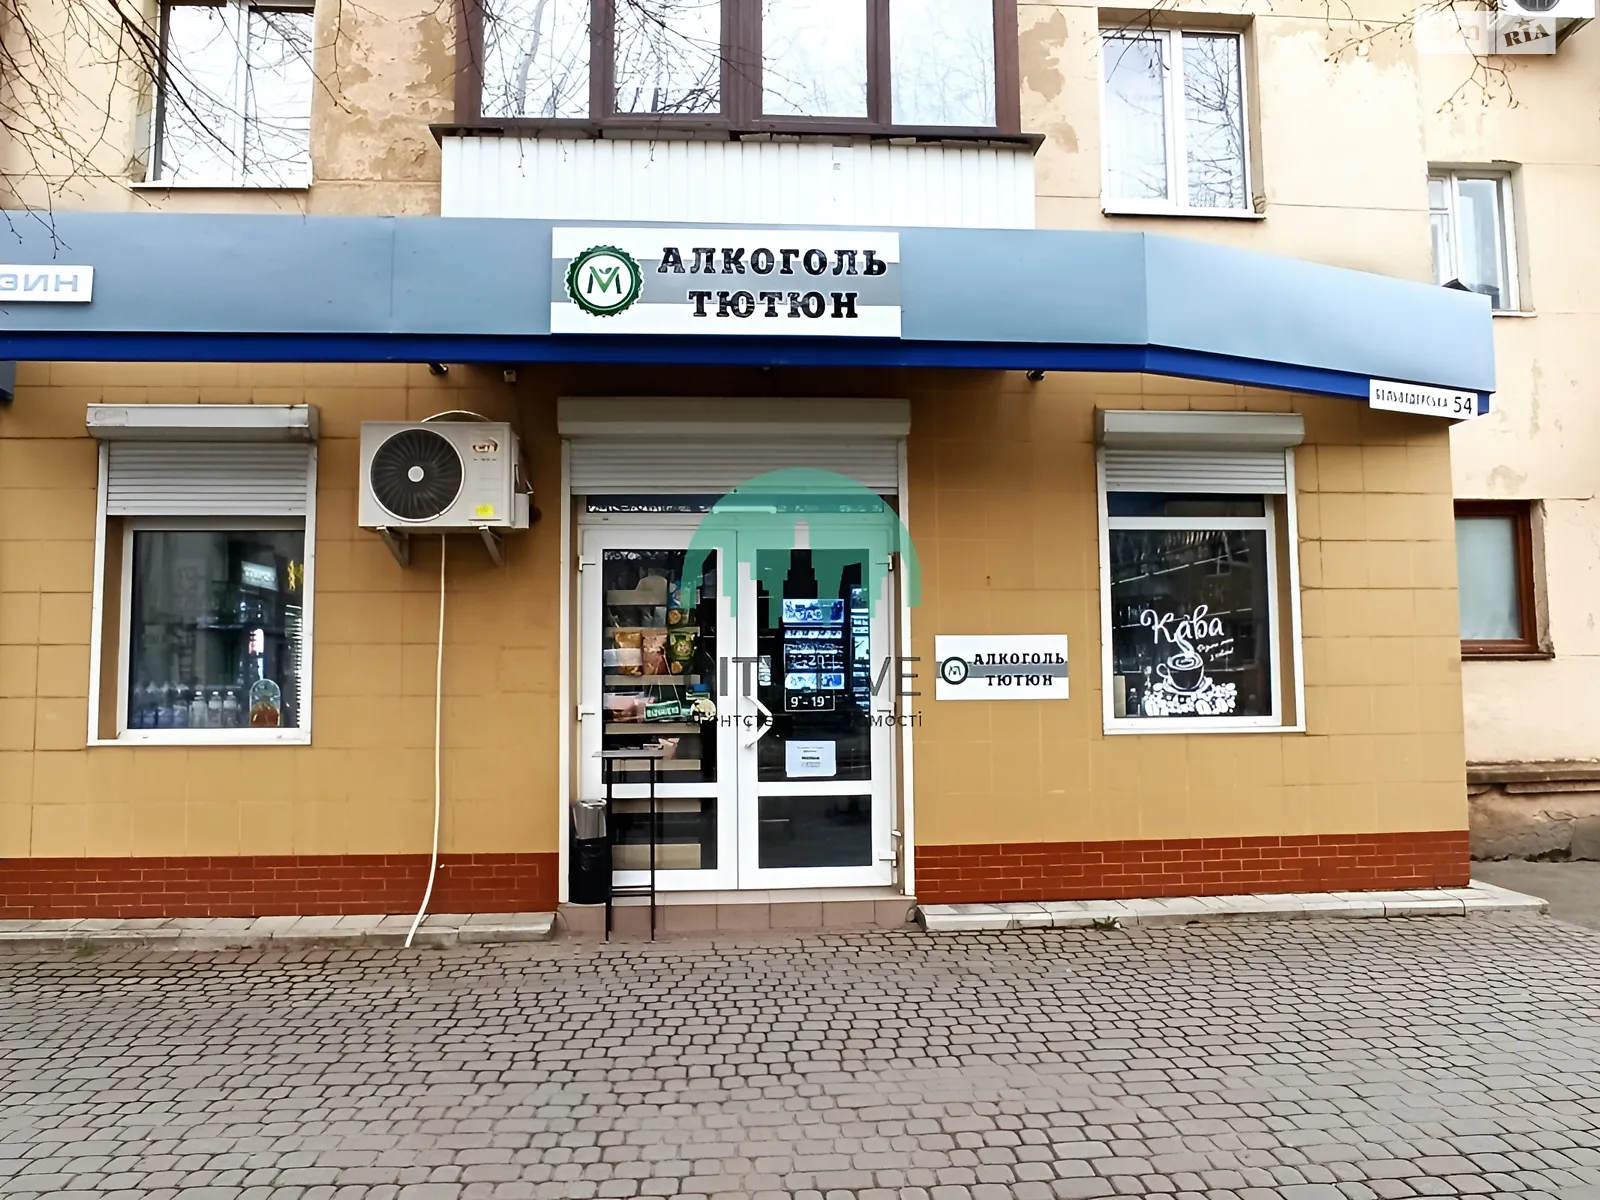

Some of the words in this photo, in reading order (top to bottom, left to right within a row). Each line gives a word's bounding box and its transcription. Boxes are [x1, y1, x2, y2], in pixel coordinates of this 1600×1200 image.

[657, 246, 888, 275] АЛКОГОЛЬ
[688, 290, 859, 319] ТЮТЮН
[1453, 396, 1473, 415] 54
[973, 652, 1065, 665] АЛКОГОЛЬ
[985, 674, 1053, 686] ТЮТЮН
